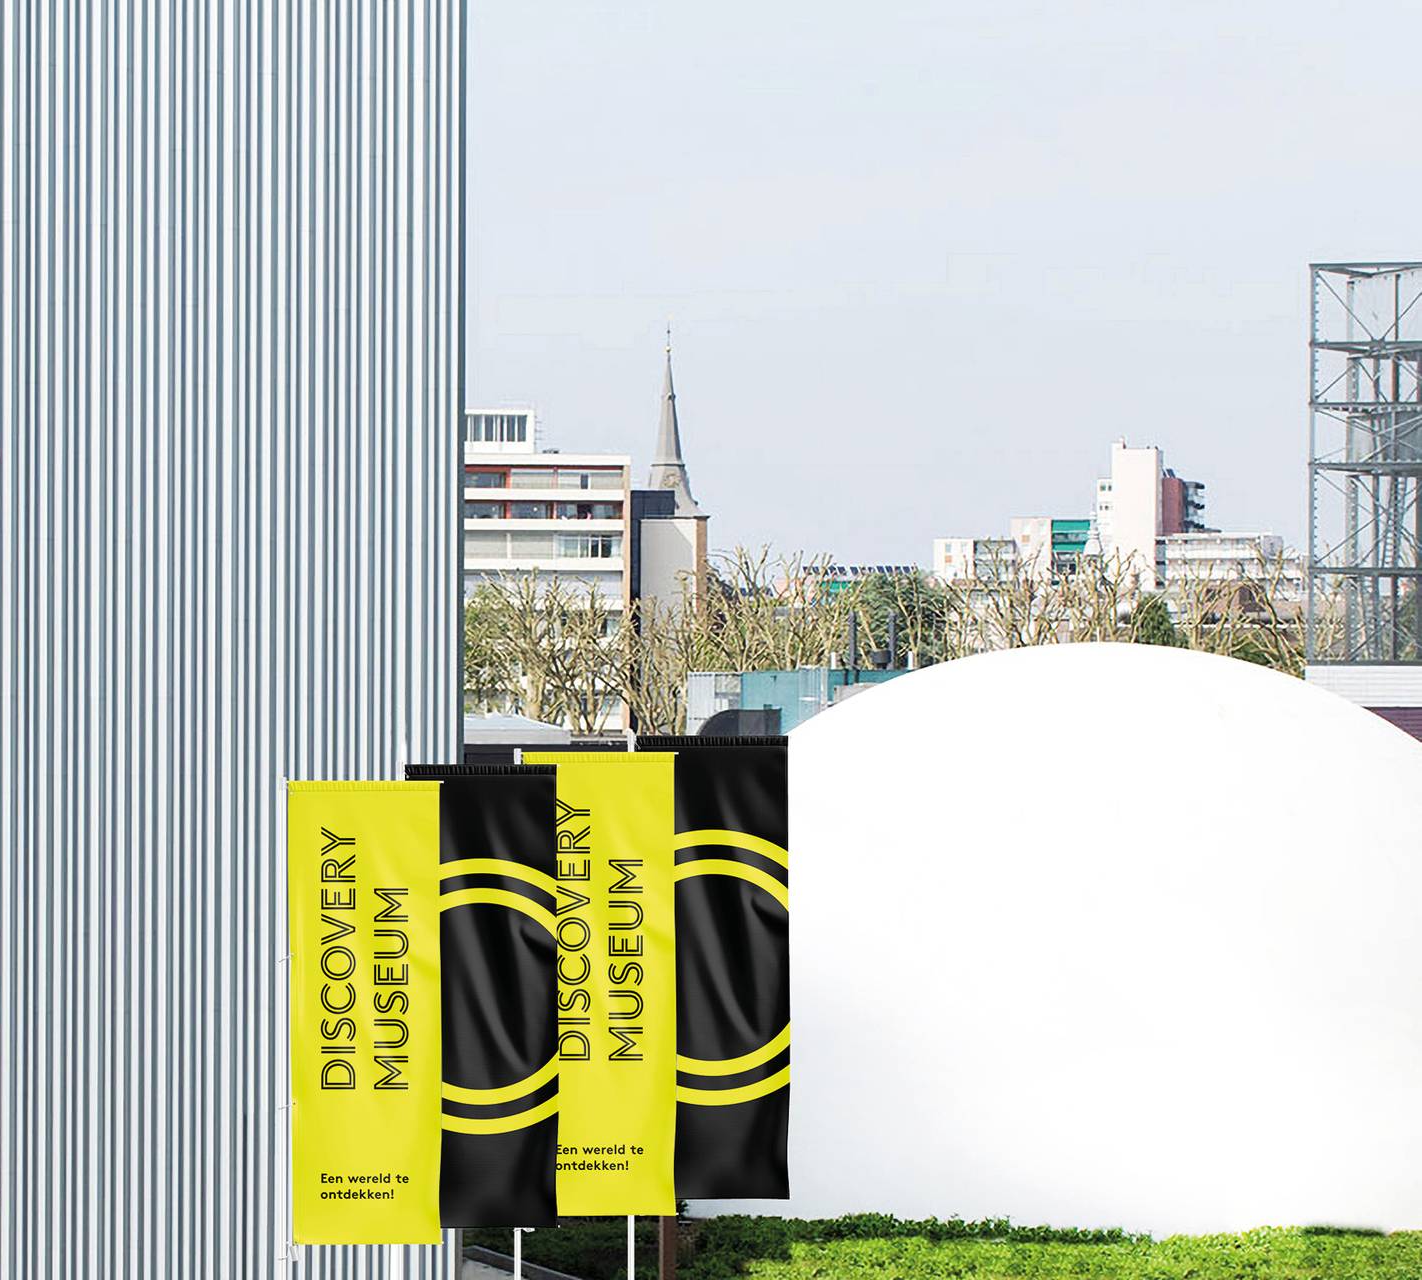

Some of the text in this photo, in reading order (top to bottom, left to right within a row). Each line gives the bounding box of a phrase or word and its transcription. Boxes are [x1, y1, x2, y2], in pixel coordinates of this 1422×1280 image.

[320, 826, 357, 1091] DISCOVERY
[556, 798, 591, 1062] DISCOVERY
[608, 859, 644, 1062] MUSEUM
[373, 887, 410, 1091] MUSEUM
[320, 1173, 410, 1184] Een wereld te
[320, 1188, 394, 1200] ontdekken!
[556, 1144, 644, 1155] Een wereld te
[556, 1160, 629, 1171] ontdekken!
